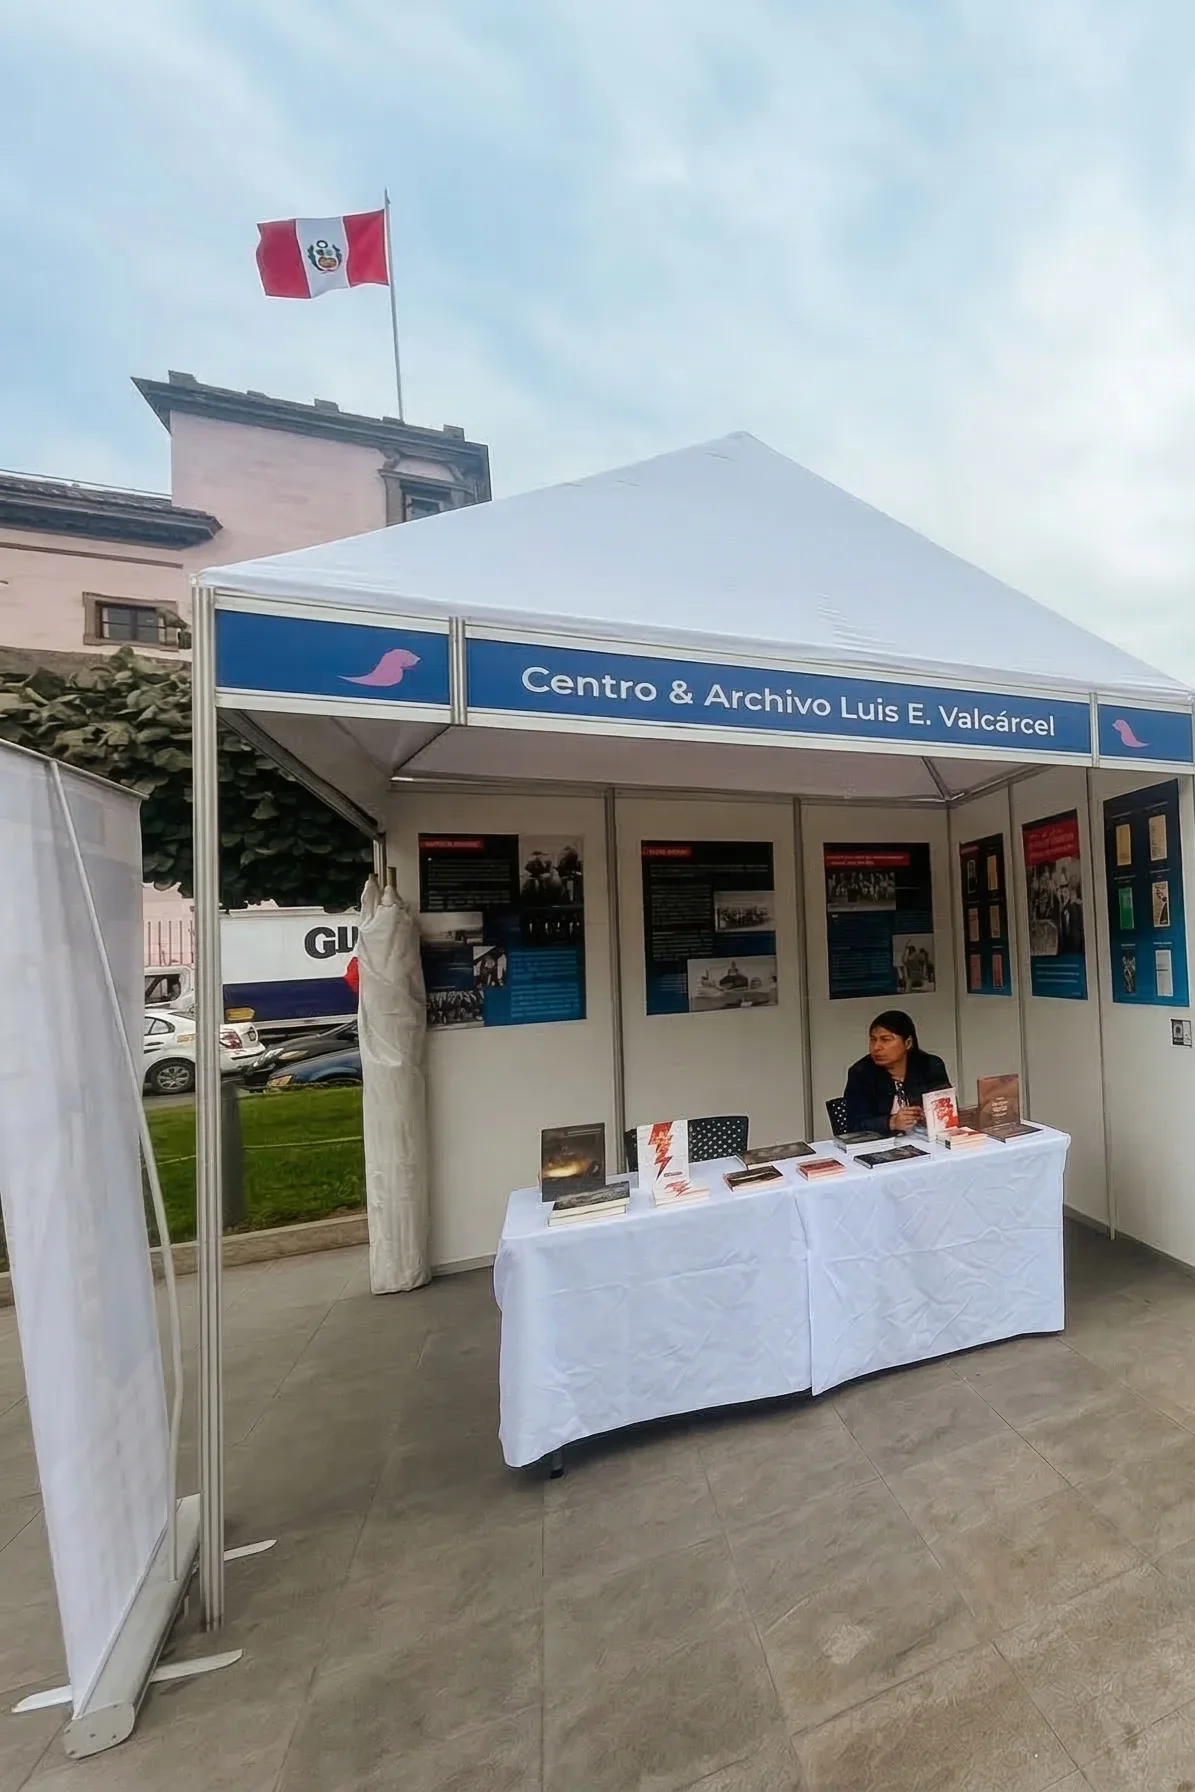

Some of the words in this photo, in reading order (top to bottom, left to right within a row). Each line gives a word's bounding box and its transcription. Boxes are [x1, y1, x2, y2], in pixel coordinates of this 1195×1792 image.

[521, 666, 657, 702] Centro
[668, 680, 694, 704] &
[704, 684, 832, 717] Archivo
[840, 696, 899, 723] Luis
[908, 703, 931, 726] E.
[938, 705, 1055, 736] Valcárcel
